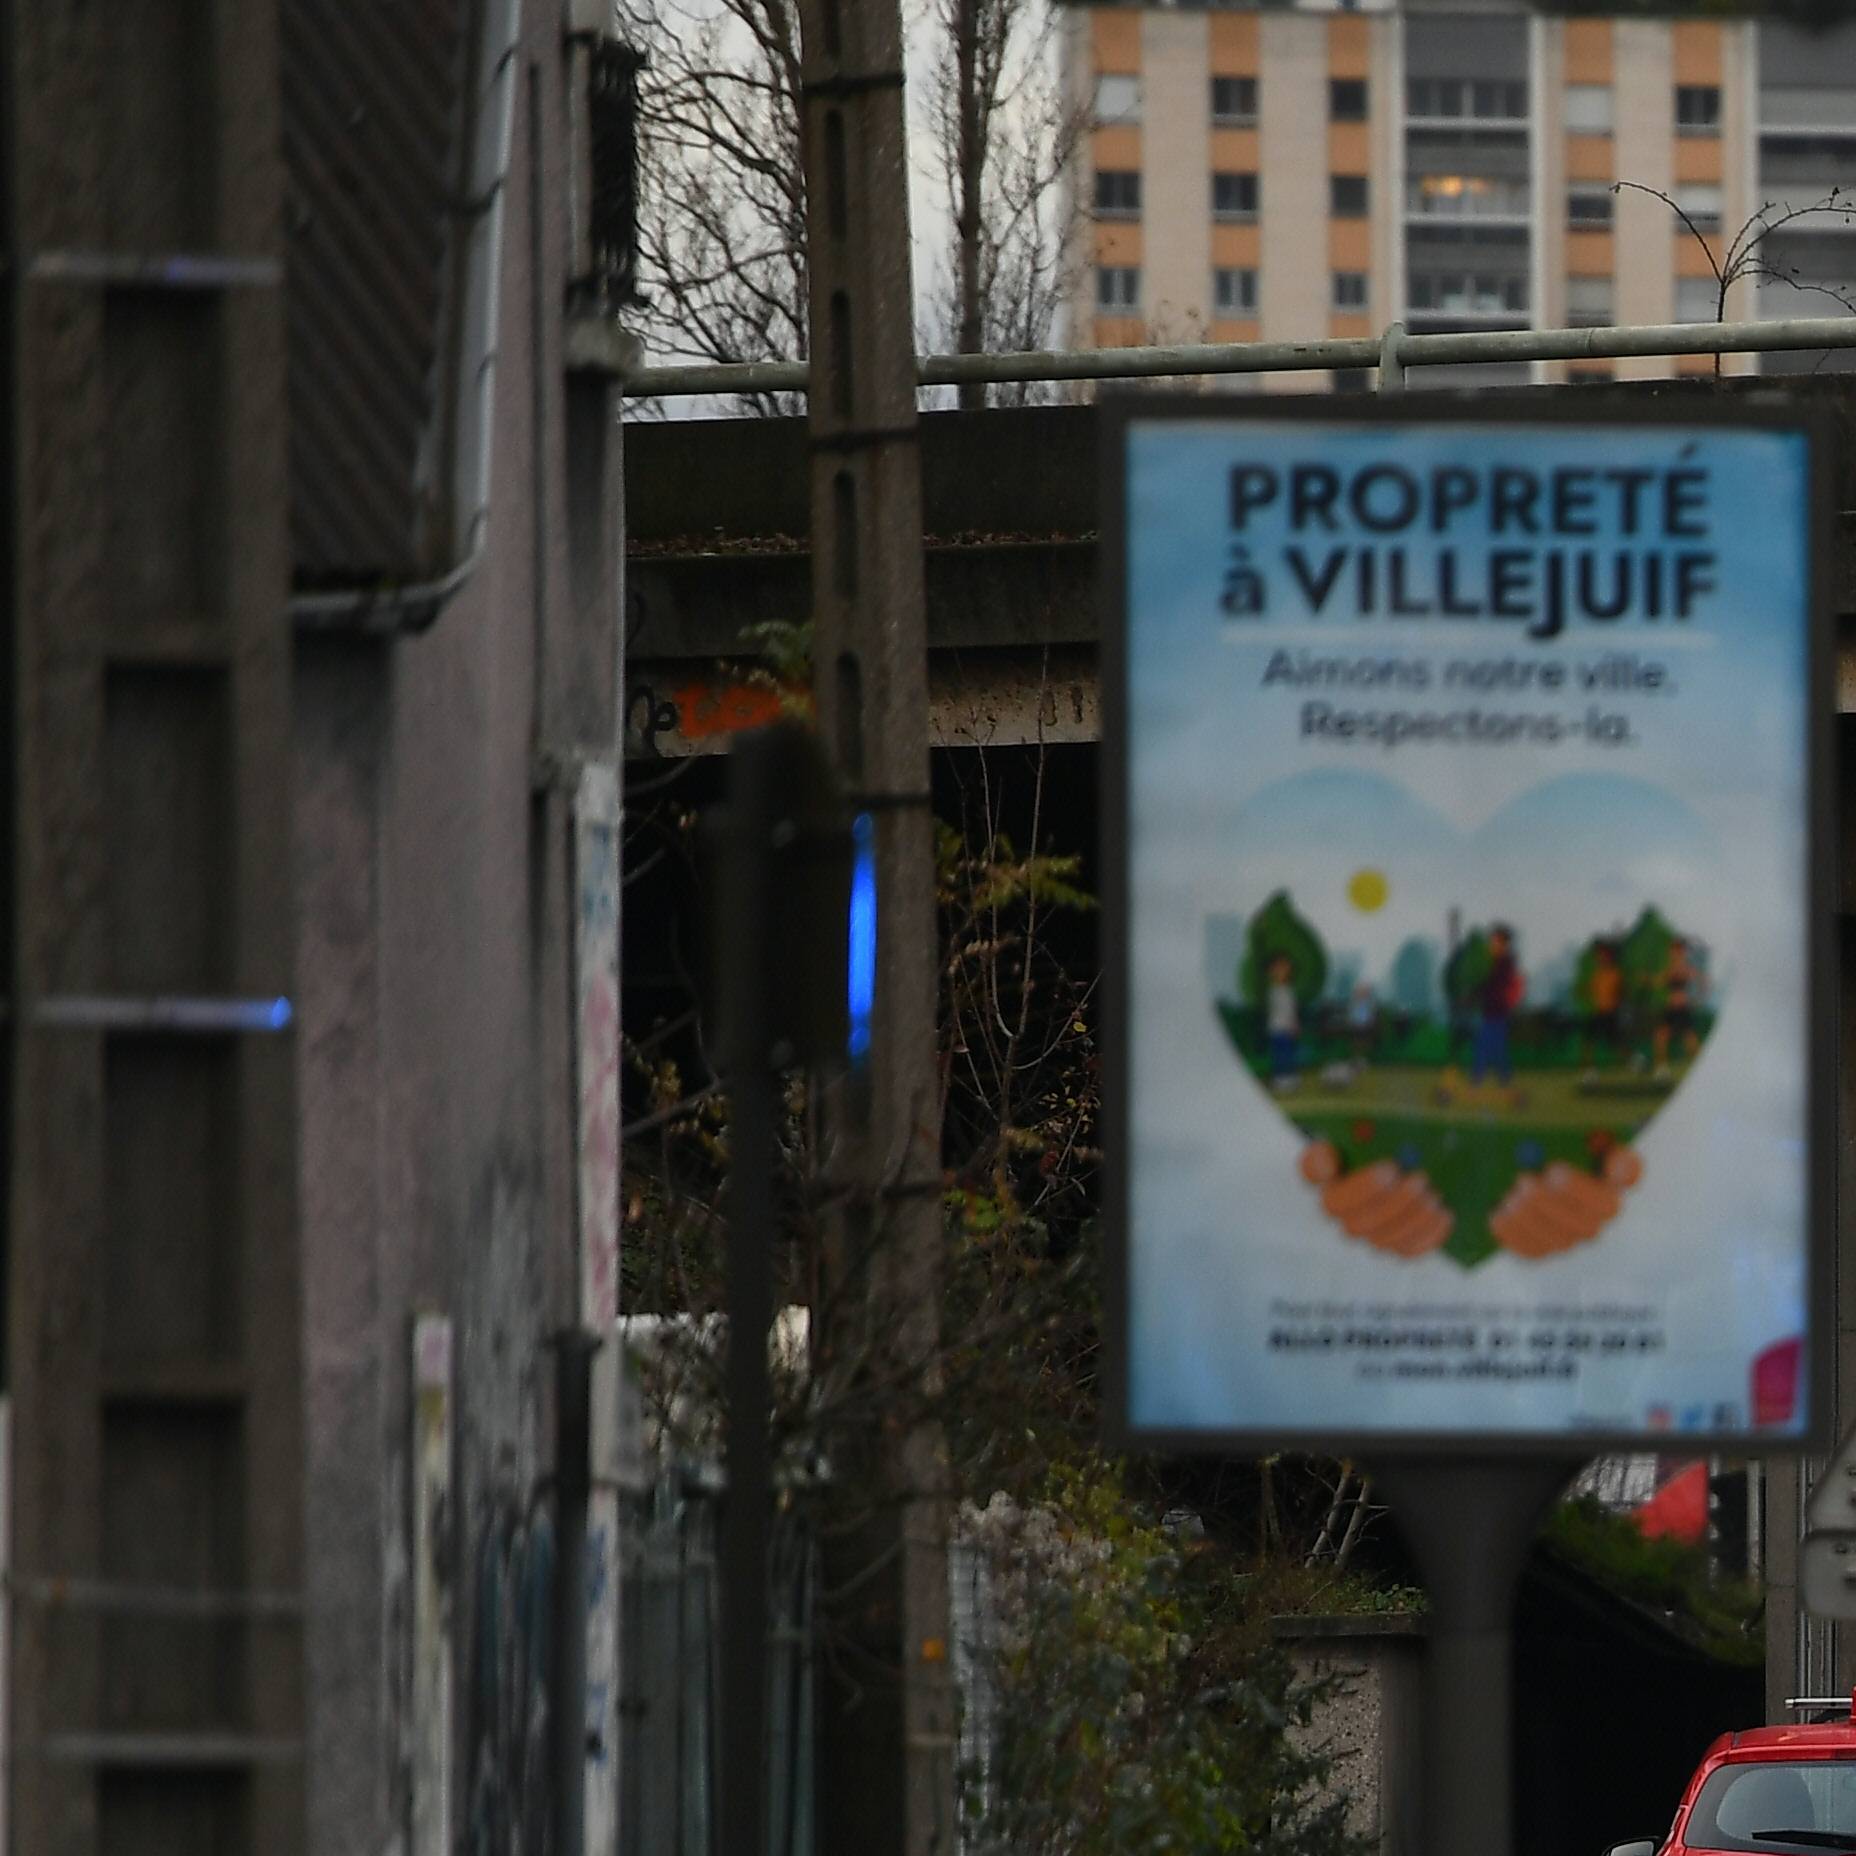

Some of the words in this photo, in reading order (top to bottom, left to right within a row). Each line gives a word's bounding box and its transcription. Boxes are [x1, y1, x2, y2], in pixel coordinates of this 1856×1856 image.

[1229, 443, 1711, 538] PROPRETÉ
[1220, 545, 1266, 615] à
[1283, 546, 1717, 639] VILLEJUIF
[1262, 650, 1429, 690] Aimons
[1443, 652, 1563, 690] notre
